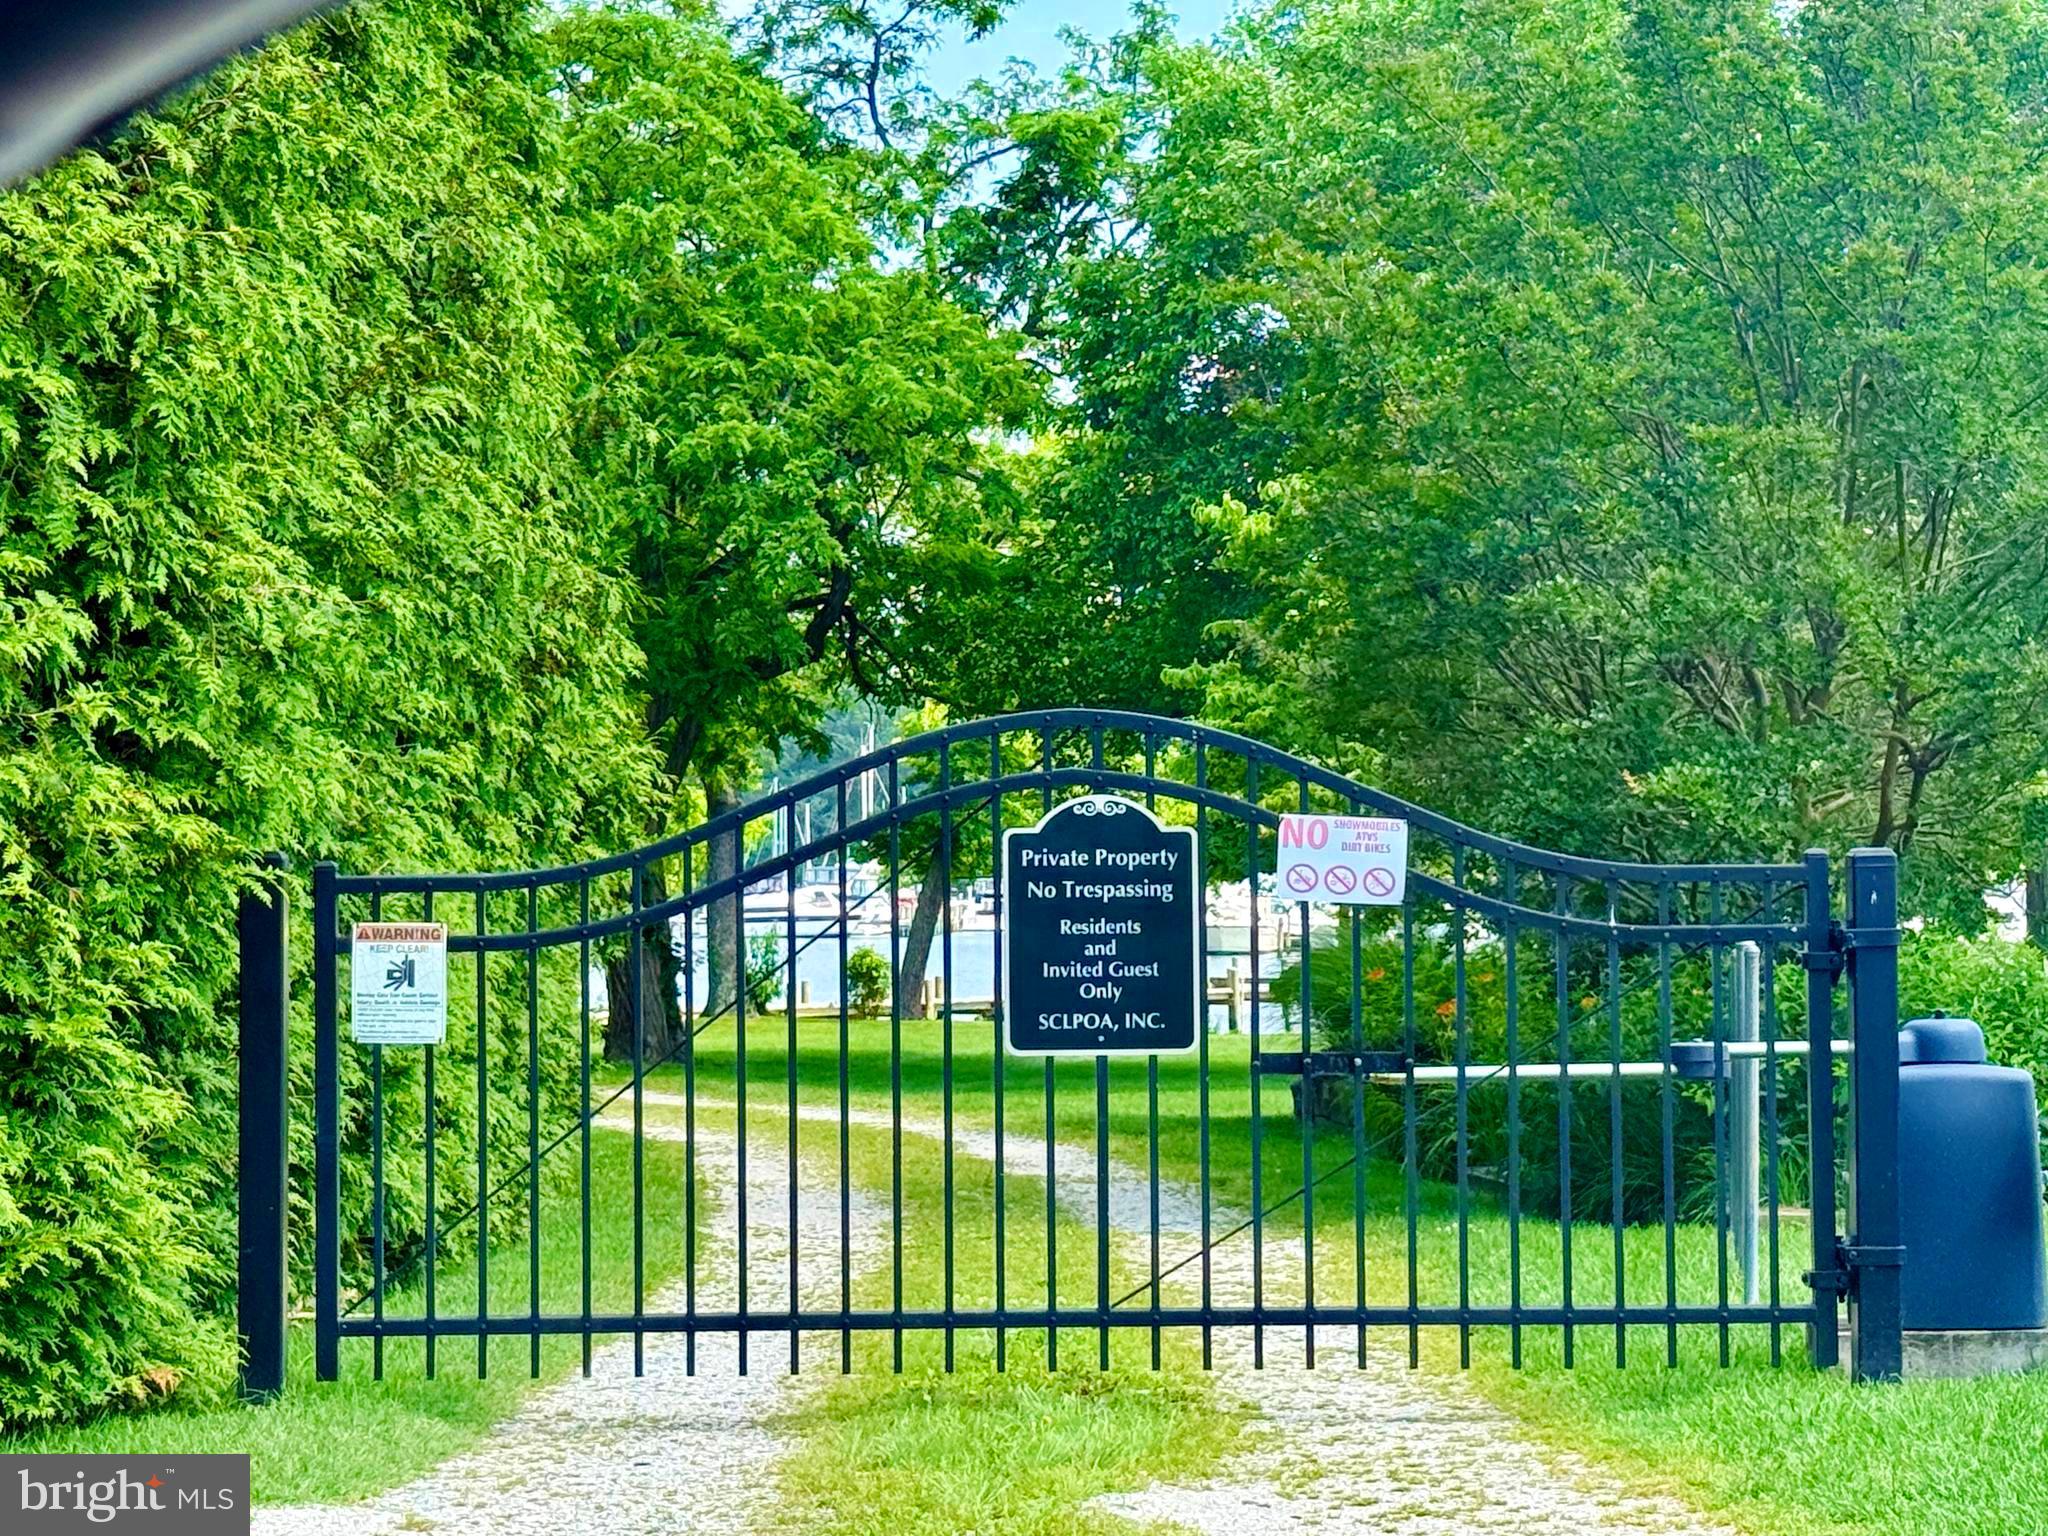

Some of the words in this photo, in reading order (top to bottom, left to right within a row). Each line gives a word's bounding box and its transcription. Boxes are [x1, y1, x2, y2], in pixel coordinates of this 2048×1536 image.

[1282, 818, 1329, 850] NO
[1364, 843, 1391, 854] BIKES
[1021, 848, 1089, 867] Private
[1095, 849, 1178, 871] Property
[1027, 881, 1056, 898] No
[1062, 879, 1174, 903] Trespassing
[371, 928, 441, 940] WARNING
[1060, 918, 1142, 935] Residents
[370, 945, 393, 953] KEEP
[1084, 939, 1117, 956] and
[1043, 961, 1103, 977] Invited
[1108, 962, 1159, 977] Guest
[1079, 982, 1123, 1003] Only
[1038, 1014, 1118, 1031] SCLPOA,
[1125, 1013, 1166, 1029] INC.
